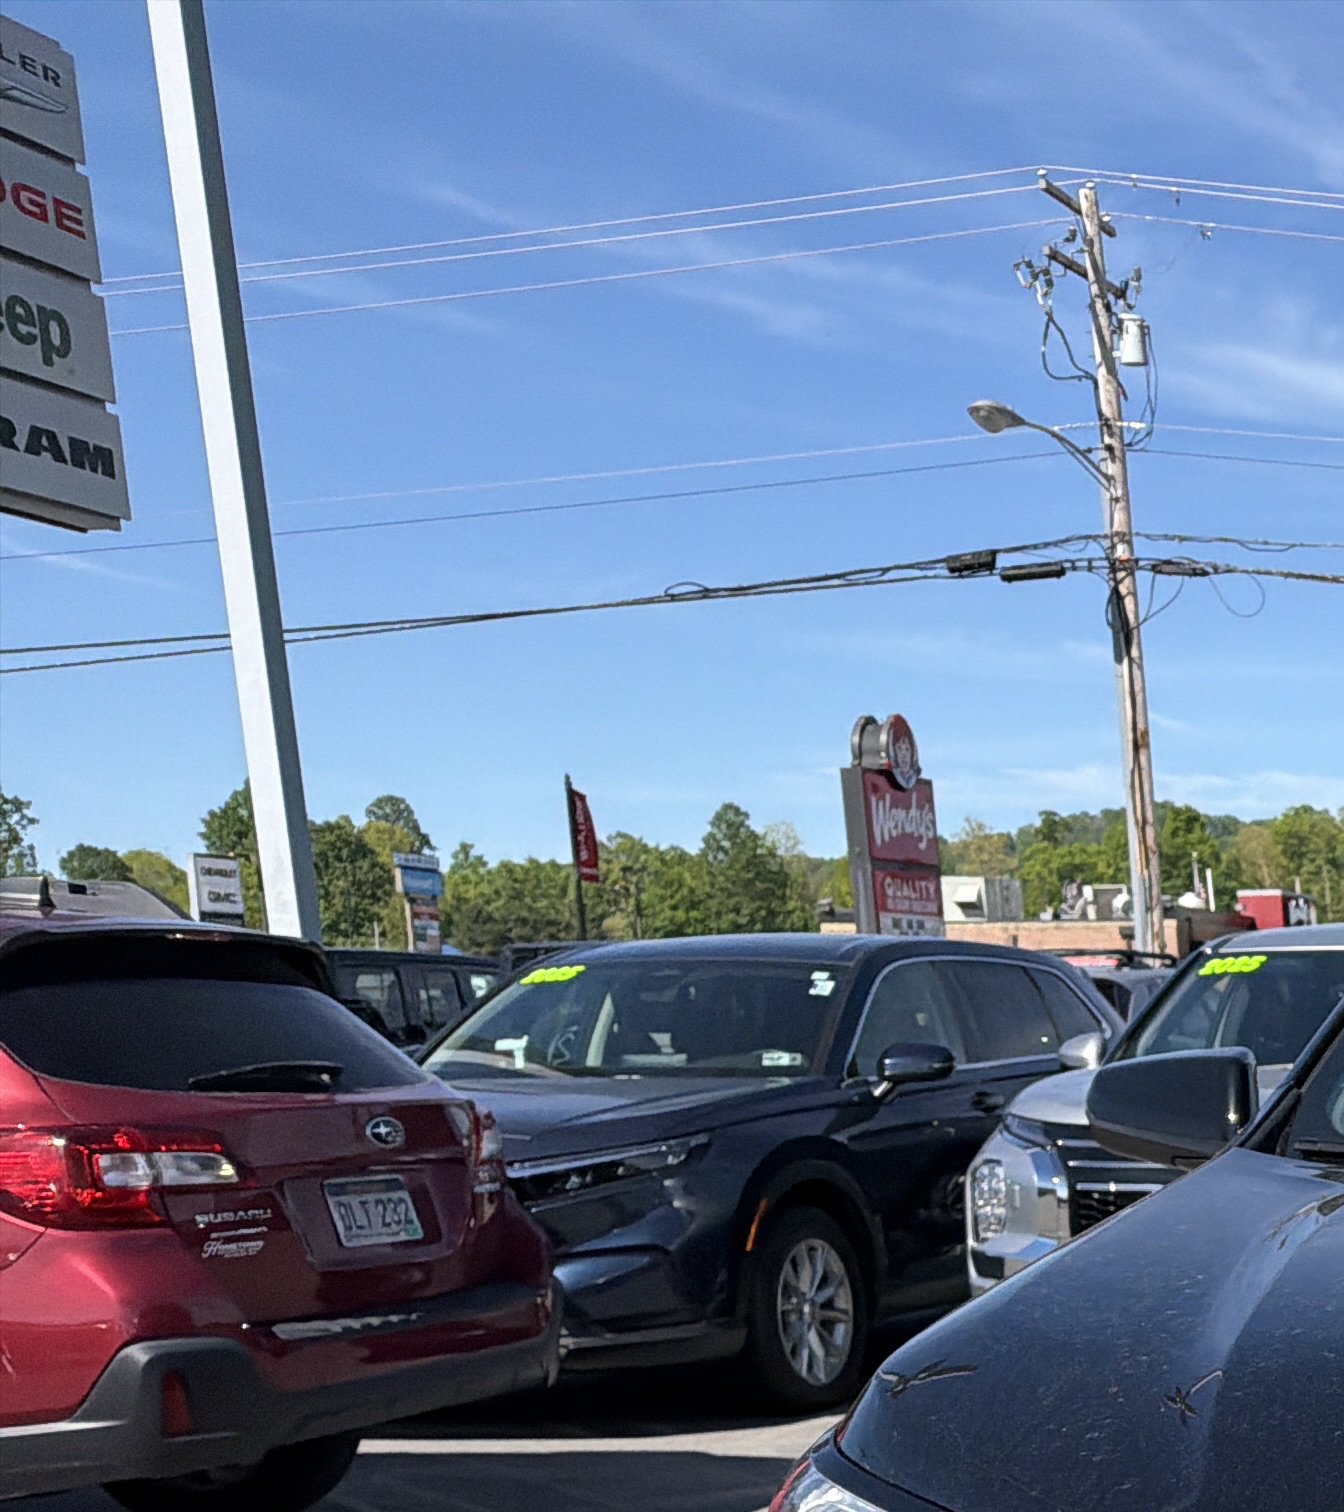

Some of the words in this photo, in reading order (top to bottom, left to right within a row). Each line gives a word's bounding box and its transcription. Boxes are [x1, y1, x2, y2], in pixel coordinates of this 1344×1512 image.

[0, 176, 87, 240] GE
[0, 294, 72, 368] ep
[871, 791, 934, 850] Wendy's
[884, 876, 936, 901] QUALITY
[1198, 955, 1268, 976] 2025
[195, 1208, 273, 1225] SUBARU
[375, 1197, 415, 1228] 232
